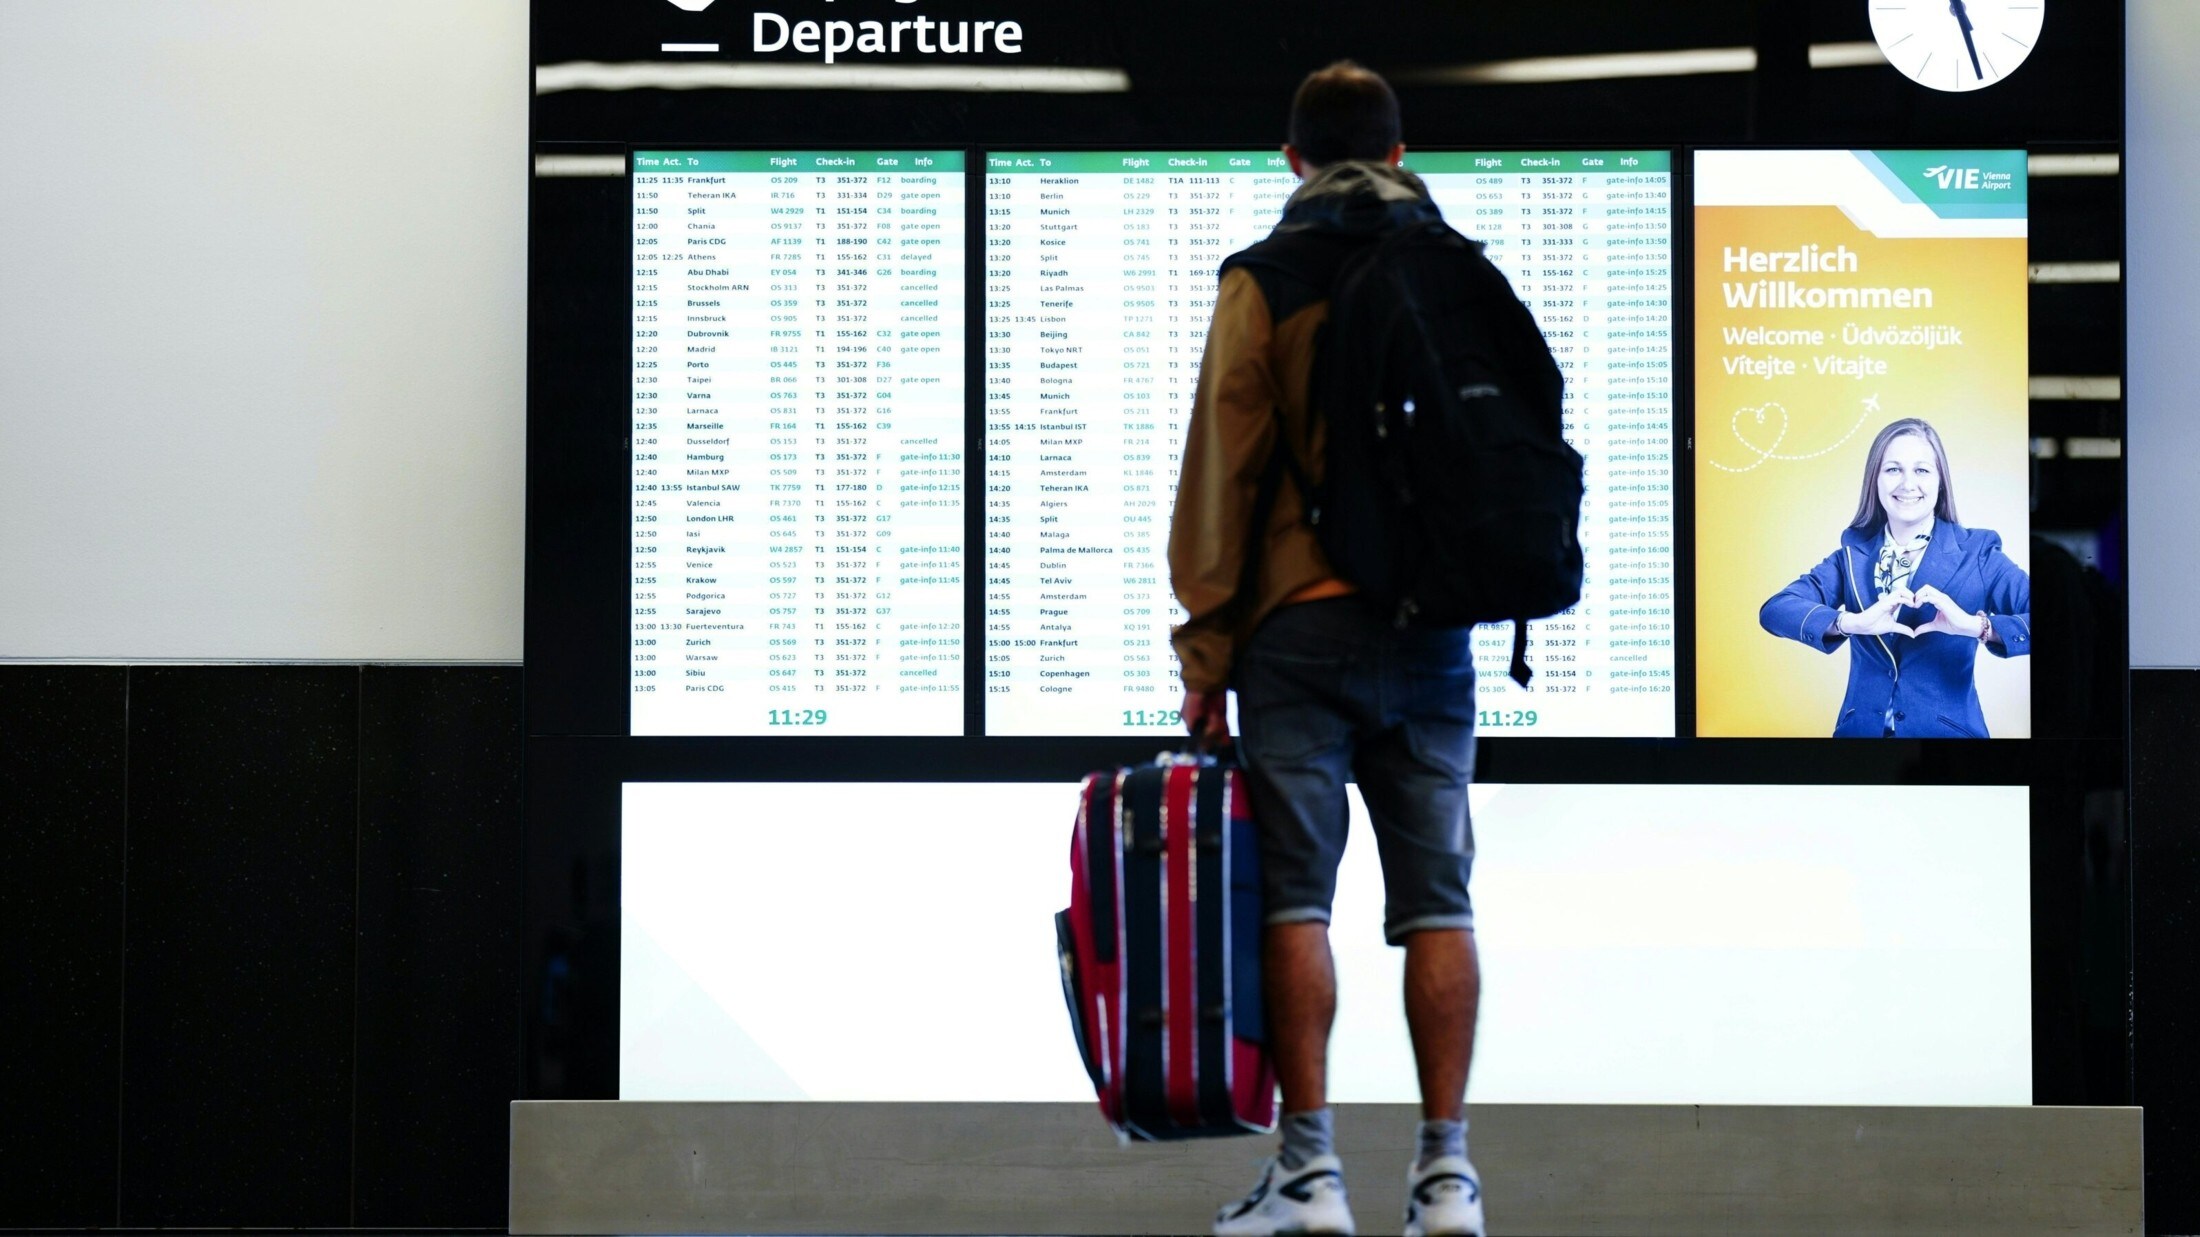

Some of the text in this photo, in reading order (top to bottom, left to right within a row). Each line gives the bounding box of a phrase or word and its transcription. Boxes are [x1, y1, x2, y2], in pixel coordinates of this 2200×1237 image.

[753, 12, 1022, 64] Departure
[636, 158, 659, 166] Time
[663, 158, 681, 166] Act.
[770, 158, 797, 168] Flight
[915, 157, 932, 166] Info
[989, 158, 1012, 166] Time
[1040, 158, 1051, 166] To
[1123, 158, 1149, 168] Flight
[1168, 158, 1207, 166] Check-in
[1229, 158, 1251, 166] Gate
[1268, 158, 1286, 167] Info
[1475, 157, 1638, 168] Flight Check-in Gate Info
[688, 176, 726, 185] Frankfurt
[877, 176, 891, 184] F12
[900, 176, 937, 185] boarding
[1606, 176, 1643, 185] gate-info
[1938, 168, 1979, 189] VIE
[1983, 172, 2010, 180] Vienna
[1982, 181, 2011, 190] Airport
[687, 207, 706, 216] Split
[785, 207, 804, 215] 2929
[901, 207, 937, 216] boarding
[900, 238, 919, 247] gate
[1724, 244, 1858, 272] Herzlich
[1607, 268, 1644, 278] gate-info
[1646, 268, 1667, 276] 15:25
[1723, 280, 1933, 309] Willkommen
[783, 299, 798, 307] 359
[900, 299, 938, 307] cancelled
[1040, 300, 1073, 308] Tenerife
[1723, 323, 1963, 350] Welcome Üdvözöljük
[1723, 354, 1888, 380] Vítejte Vitajte
[989, 423, 1011, 431] 13:55
[1608, 422, 1646, 432] gate-info
[1647, 422, 1668, 430] 14:45
[687, 453, 724, 462] Hamburg
[769, 453, 782, 461] OS
[783, 453, 797, 461] 173
[836, 453, 867, 461] 351-372
[900, 453, 938, 462] gate-info
[686, 546, 726, 555] Reykjavik
[899, 545, 937, 555] gate-info
[1123, 546, 1135, 554] OS
[836, 638, 866, 646] 351-372
[899, 638, 937, 647] gate-info
[938, 638, 960, 646] 11:50
[1478, 639, 1490, 647] OS
[1609, 639, 1647, 648] gate-info
[1609, 654, 1648, 662] cancelled
[1040, 670, 1090, 679] Copenhagen
[1546, 685, 1576, 693] 351-372
[1610, 685, 1648, 694] gate-info
[769, 710, 827, 725] 11:29
[1124, 710, 1182, 726] 11:29
[1479, 710, 1537, 726] 11:29
